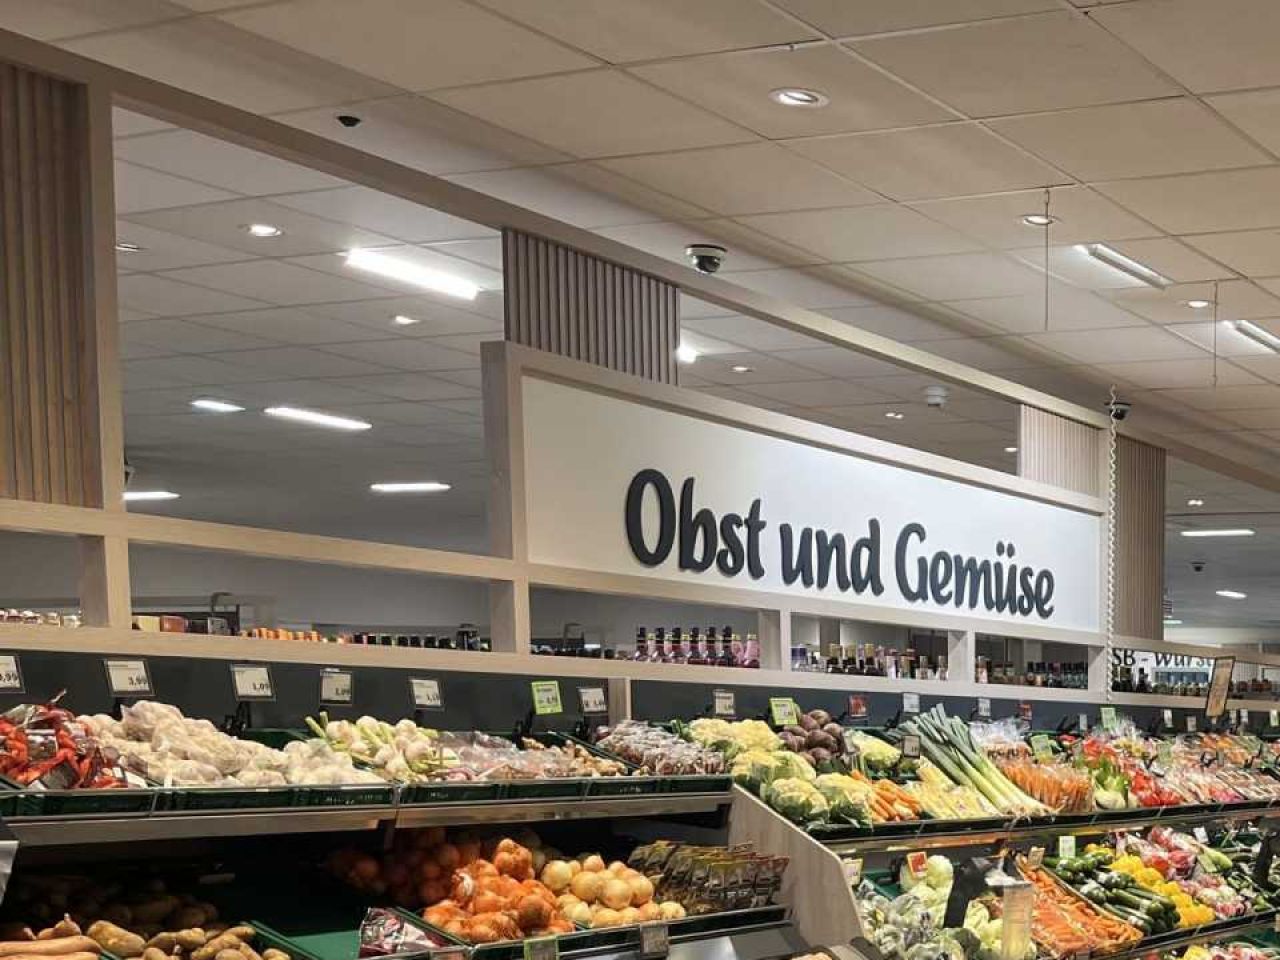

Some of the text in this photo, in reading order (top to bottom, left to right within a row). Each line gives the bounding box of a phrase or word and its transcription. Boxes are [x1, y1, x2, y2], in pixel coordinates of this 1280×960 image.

[624, 468, 1056, 619] Obst und Gemüse
